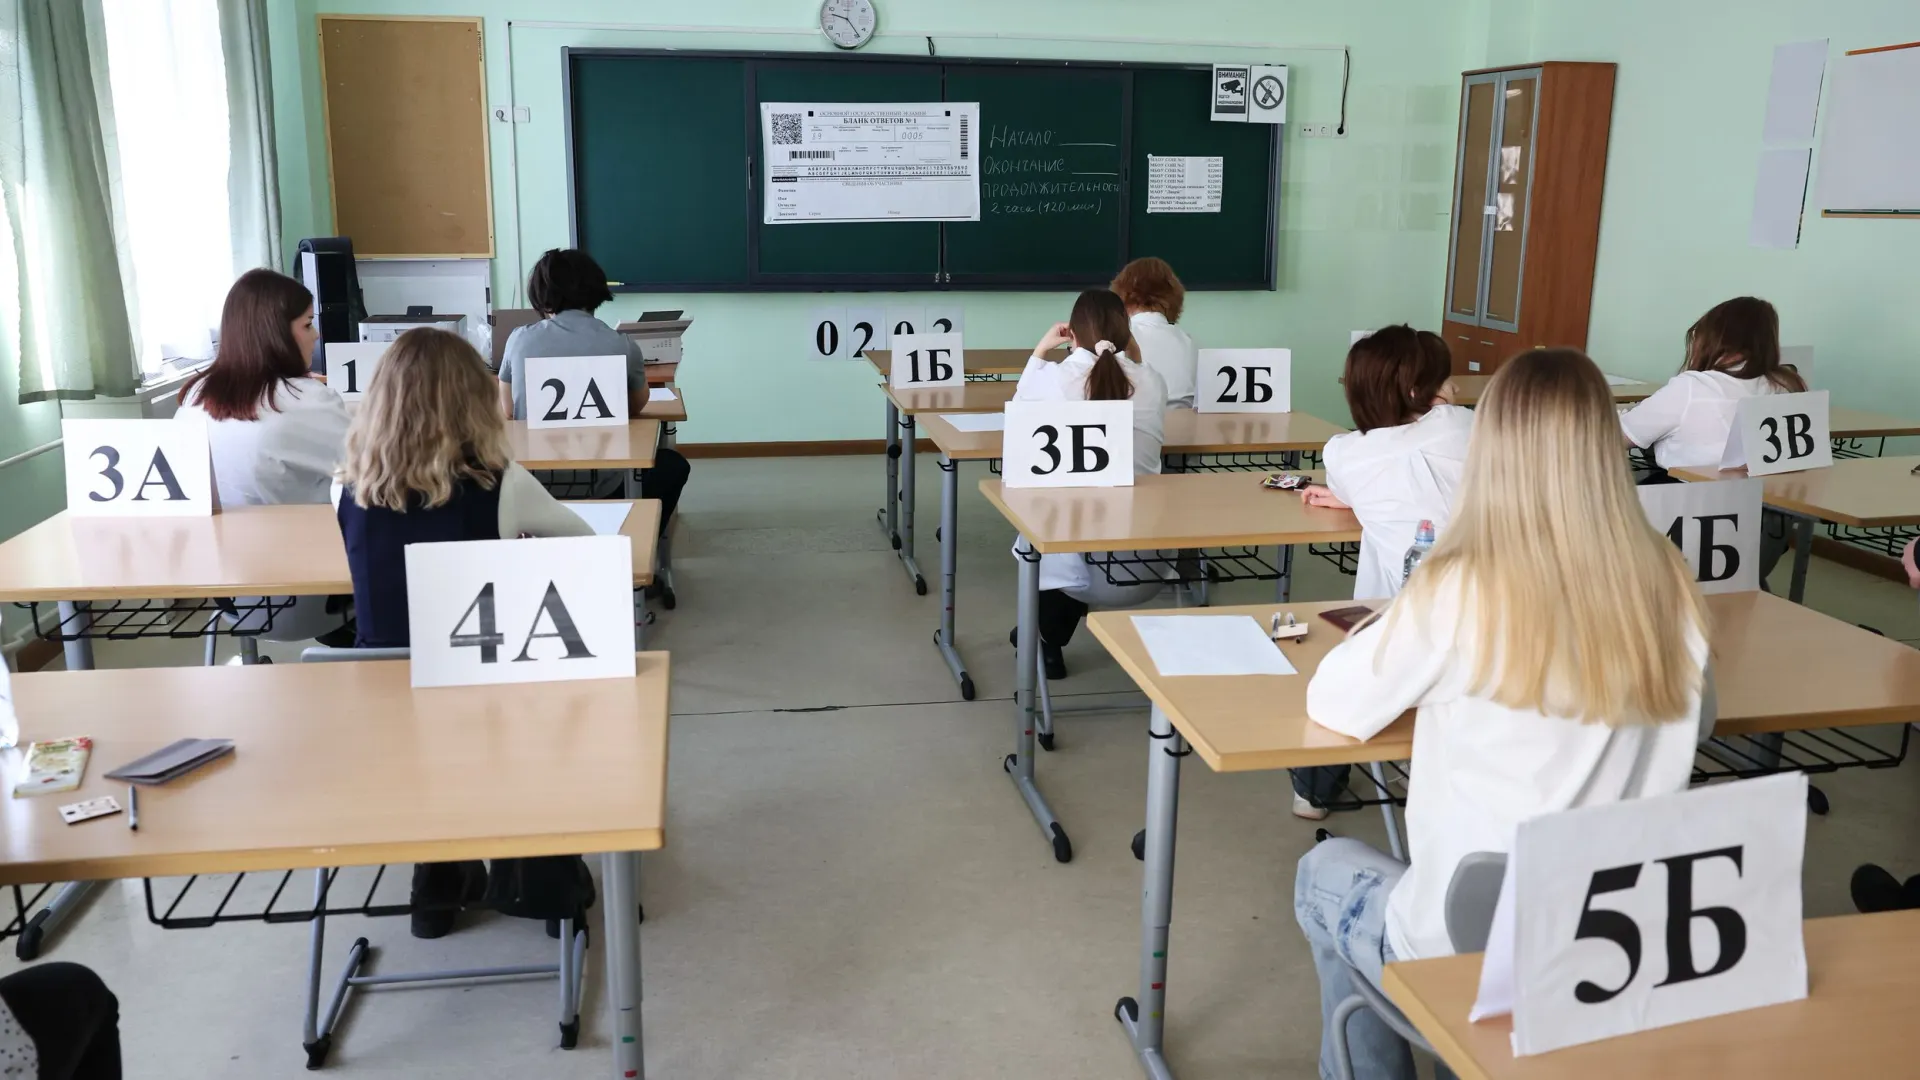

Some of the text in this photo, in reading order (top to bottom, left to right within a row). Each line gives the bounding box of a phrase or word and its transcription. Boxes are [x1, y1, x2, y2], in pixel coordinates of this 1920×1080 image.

[1218, 71, 1246, 79] ВНИМАНИЕ
[901, 131, 923, 140] 0005
[991, 202, 1001, 214] 2
[906, 349, 954, 383] 1Б
[1216, 366, 1273, 403] 2Б
[540, 377, 616, 421] 2А
[1030, 424, 1110, 475] 3Б
[1759, 413, 1815, 464] 3В
[87, 445, 190, 502] 3А
[449, 580, 597, 664] 4А
[1574, 845, 1747, 1004] 5Б
